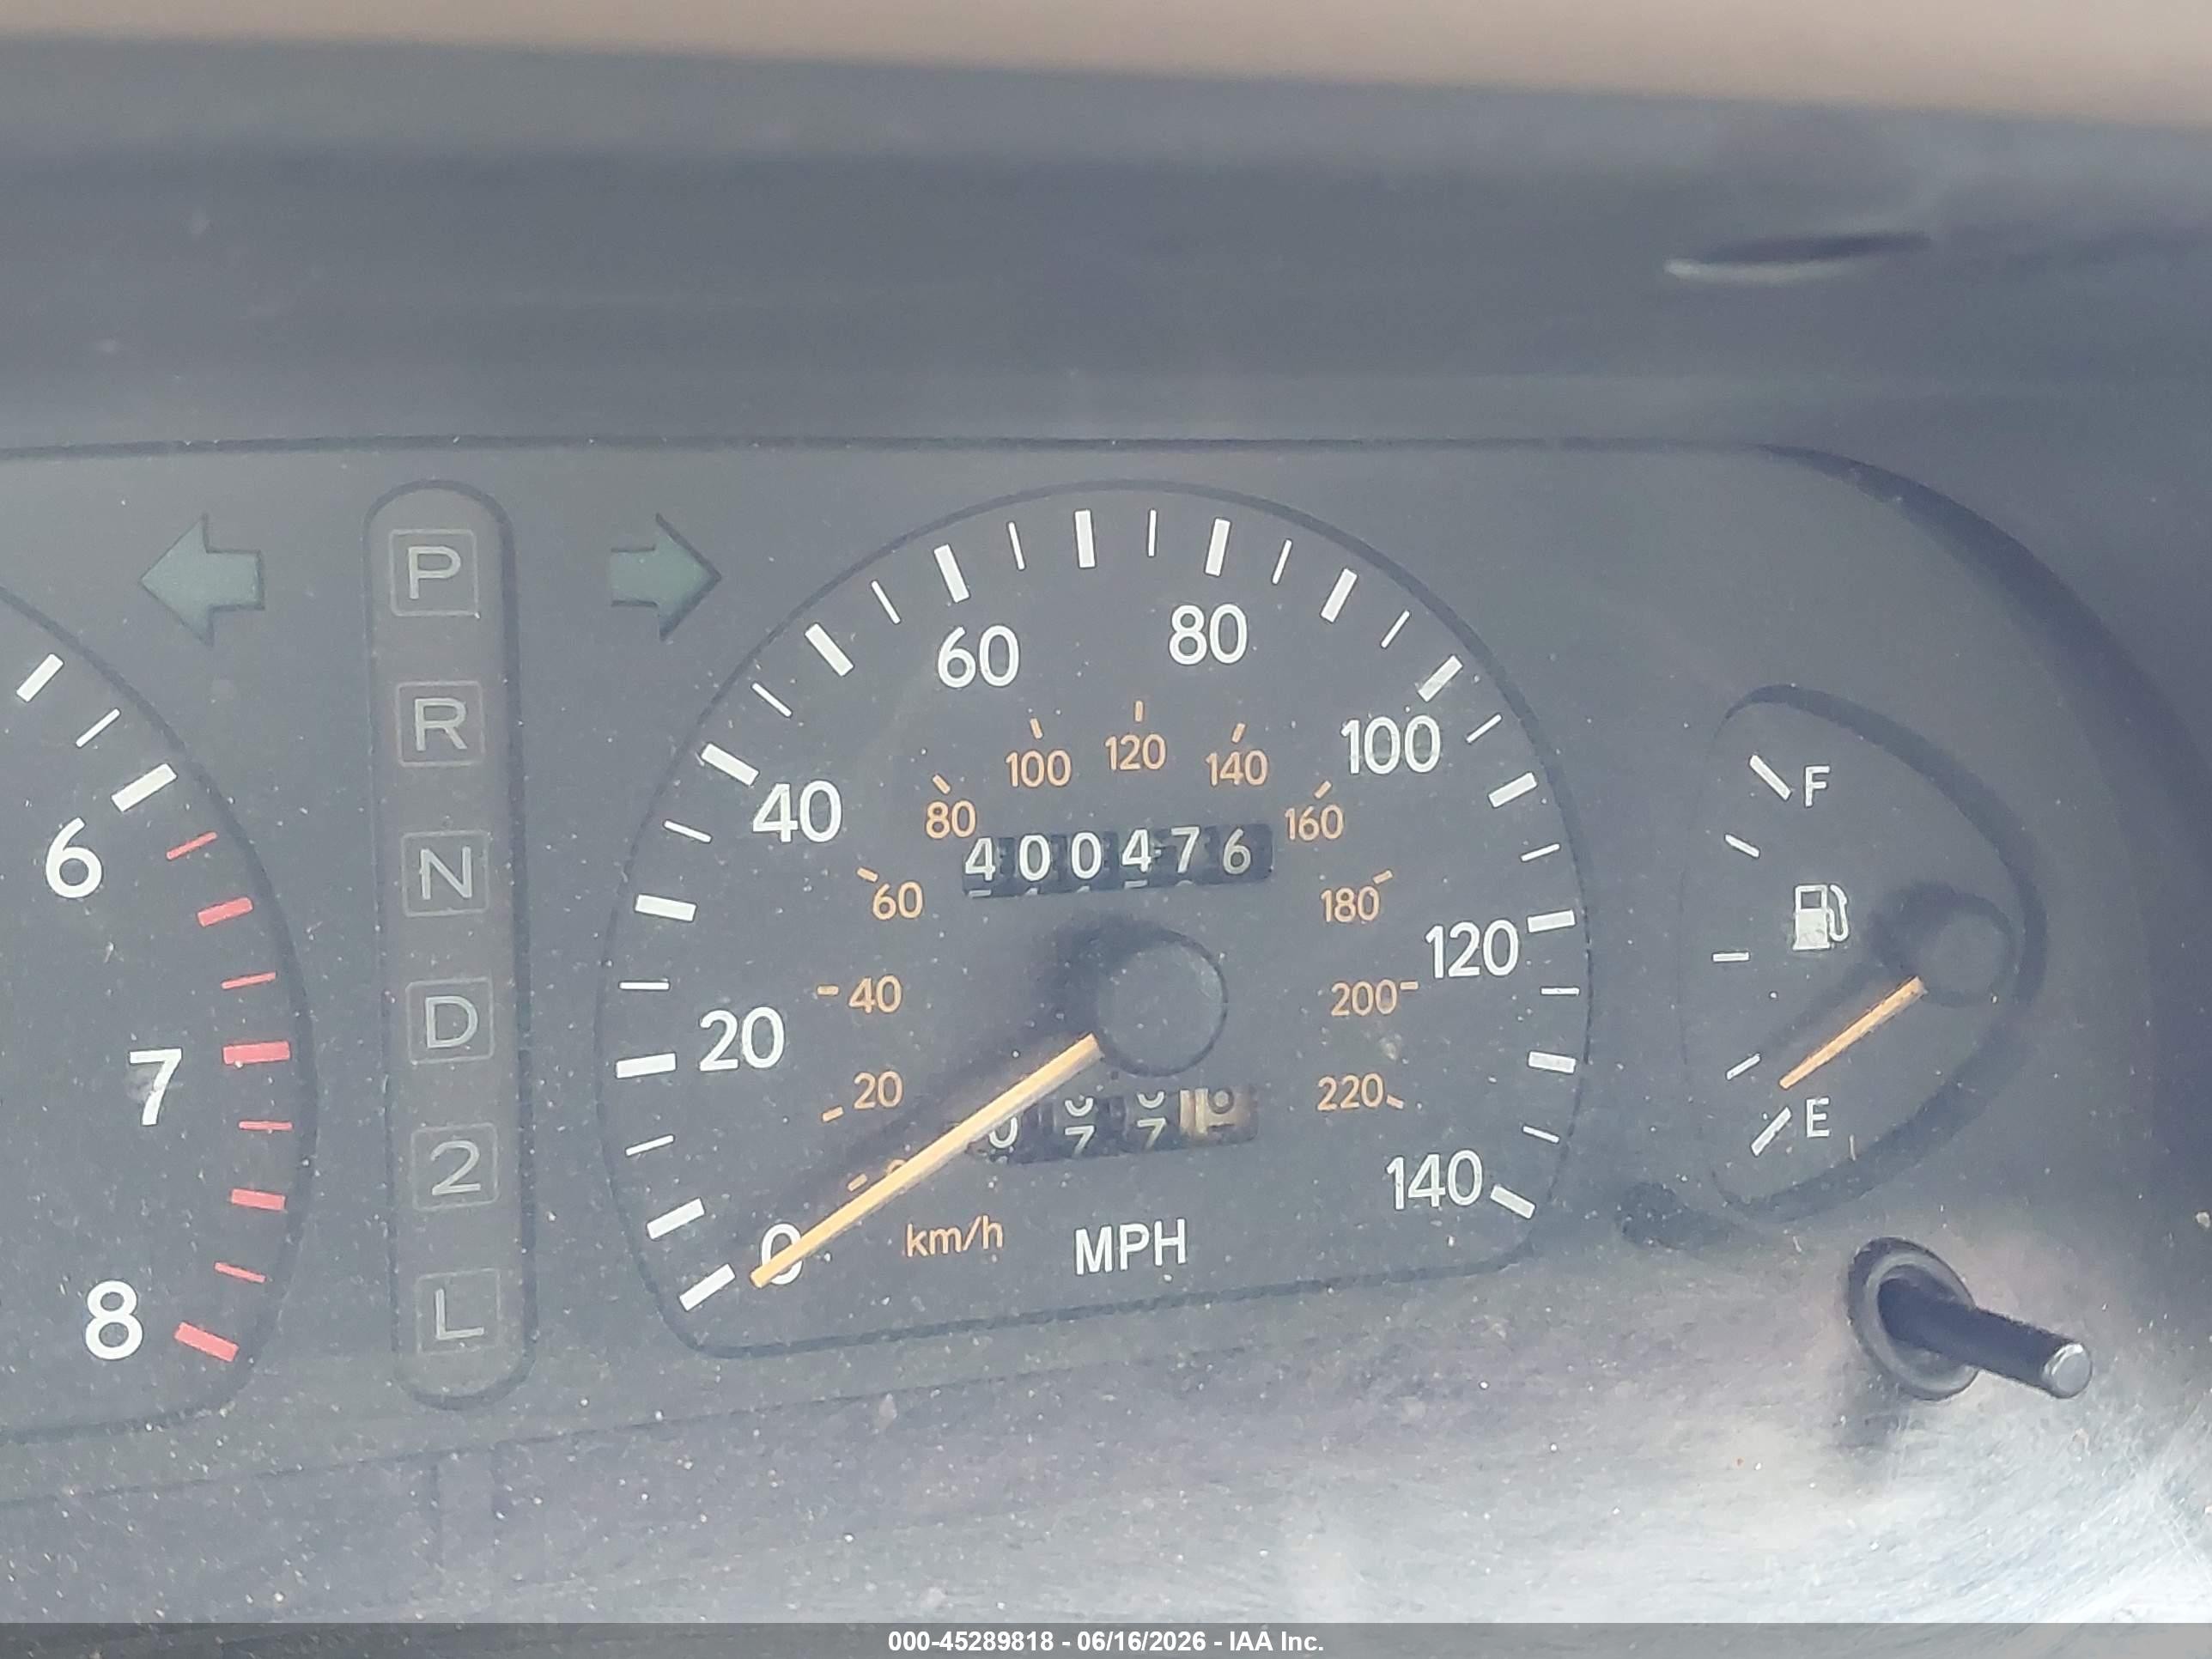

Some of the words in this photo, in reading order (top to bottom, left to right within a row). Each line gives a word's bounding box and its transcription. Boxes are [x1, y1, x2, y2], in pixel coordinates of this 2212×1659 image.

[409, 547, 461, 599] P
[937, 625, 1020, 688] 60
[1169, 604, 1248, 665] 80
[415, 697, 468, 751] R
[1340, 714, 1441, 774] 100
[1006, 749, 1072, 788] 100
[1105, 733, 1167, 771] 120
[1205, 750, 1269, 787] 140
[752, 779, 842, 843] 40
[1804, 764, 1830, 807] F
[925, 799, 976, 839] 80
[1285, 804, 1345, 842] 160
[46, 817, 102, 898] 6
[419, 846, 471, 900] N
[964, 826, 1251, 882] 400476
[872, 882, 924, 920] 60
[1320, 885, 1381, 922] 180
[1425, 919, 1519, 979] 120
[848, 975, 902, 1013] 40
[1331, 979, 1398, 1017] 200
[425, 995, 478, 1049] D
[699, 1006, 785, 1072] 20
[129, 1047, 182, 1127] 7
[854, 1071, 903, 1109] 20
[1316, 1073, 1384, 1111] 220
[1806, 1097, 1830, 1138] E
[429, 1140, 482, 1196] 2
[1386, 1149, 1483, 1211] 140
[761, 1223, 804, 1285] 0
[906, 1215, 1004, 1257] km/h
[1074, 1218, 1188, 1275] MPH
[84, 1279, 143, 1361] 8
[434, 1289, 485, 1341] L
